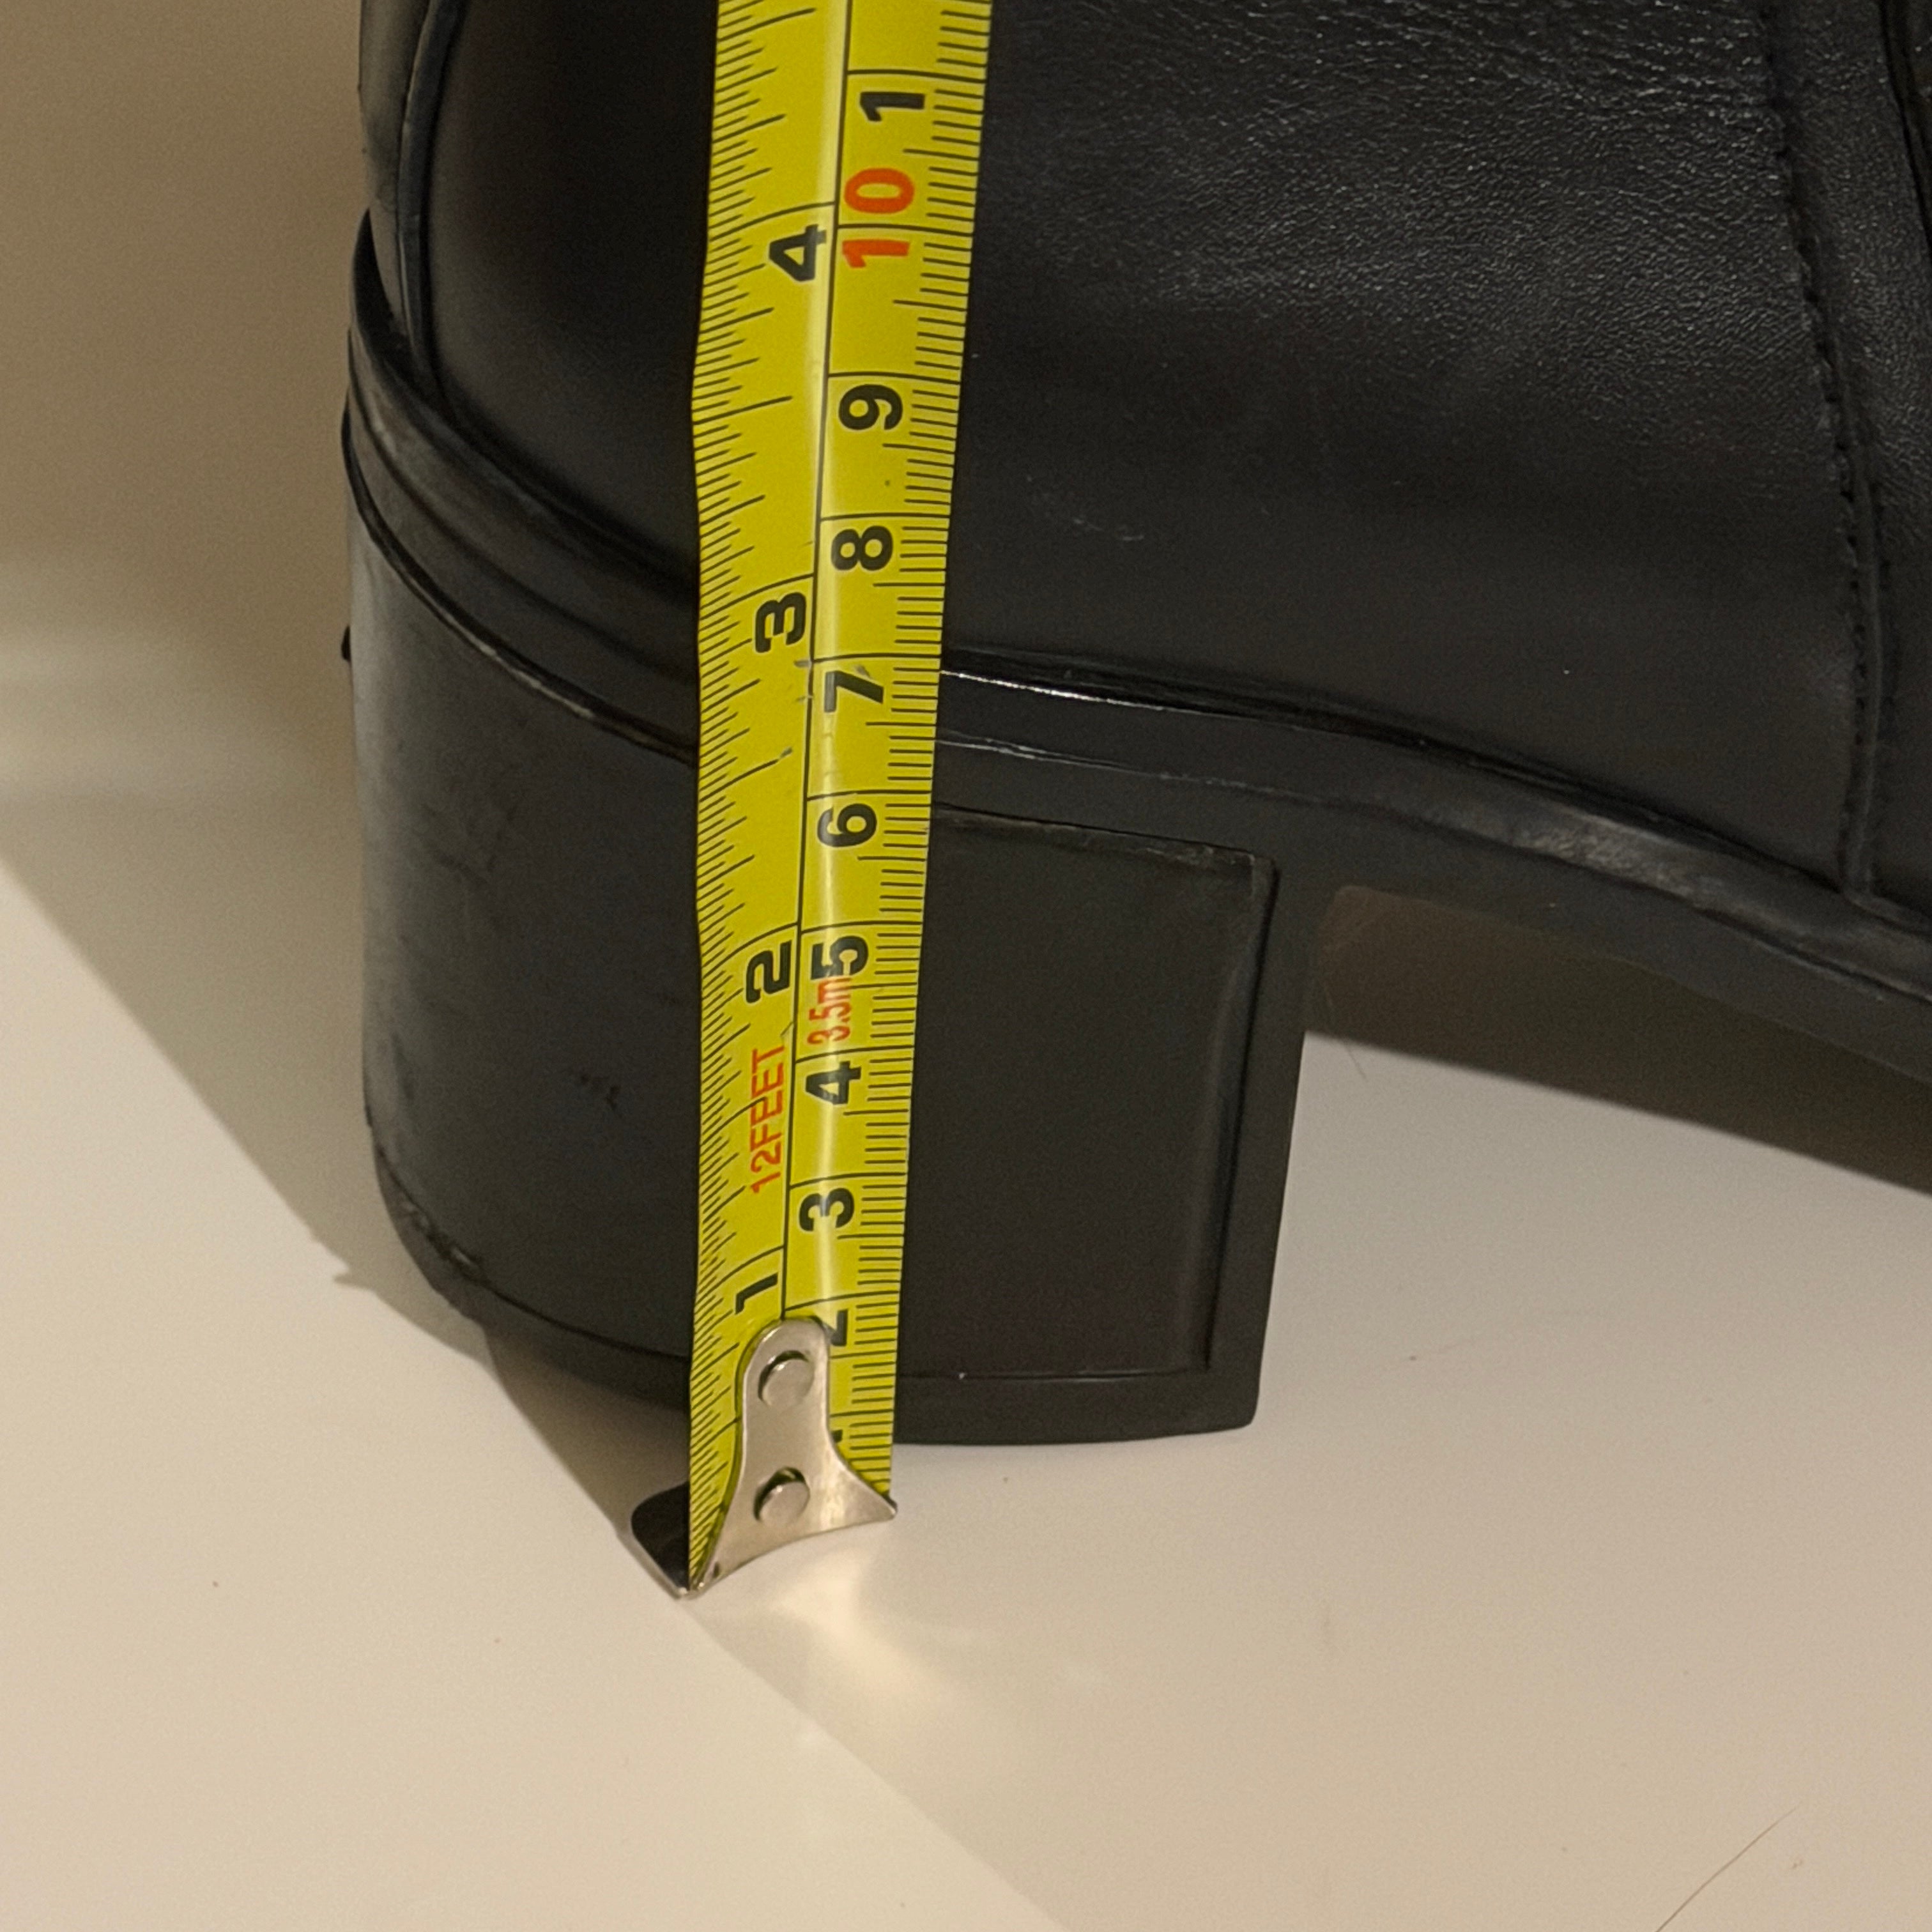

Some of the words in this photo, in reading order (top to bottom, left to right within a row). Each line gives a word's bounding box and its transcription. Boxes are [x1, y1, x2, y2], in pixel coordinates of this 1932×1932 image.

[859, 91, 925, 122] 1
[769, 224, 827, 282] 4
[838, 384, 903, 430] 9
[831, 526, 893, 571] 8
[755, 592, 806, 653] 3
[824, 670, 884, 712] 7
[816, 803, 878, 847] 6
[745, 940, 792, 1004] 2
[810, 935, 868, 980] 5
[807, 976, 852, 1045] 3.5m
[805, 1061, 861, 1105] 4
[799, 1187, 854, 1232] 3
[735, 1272, 778, 1314] 1
